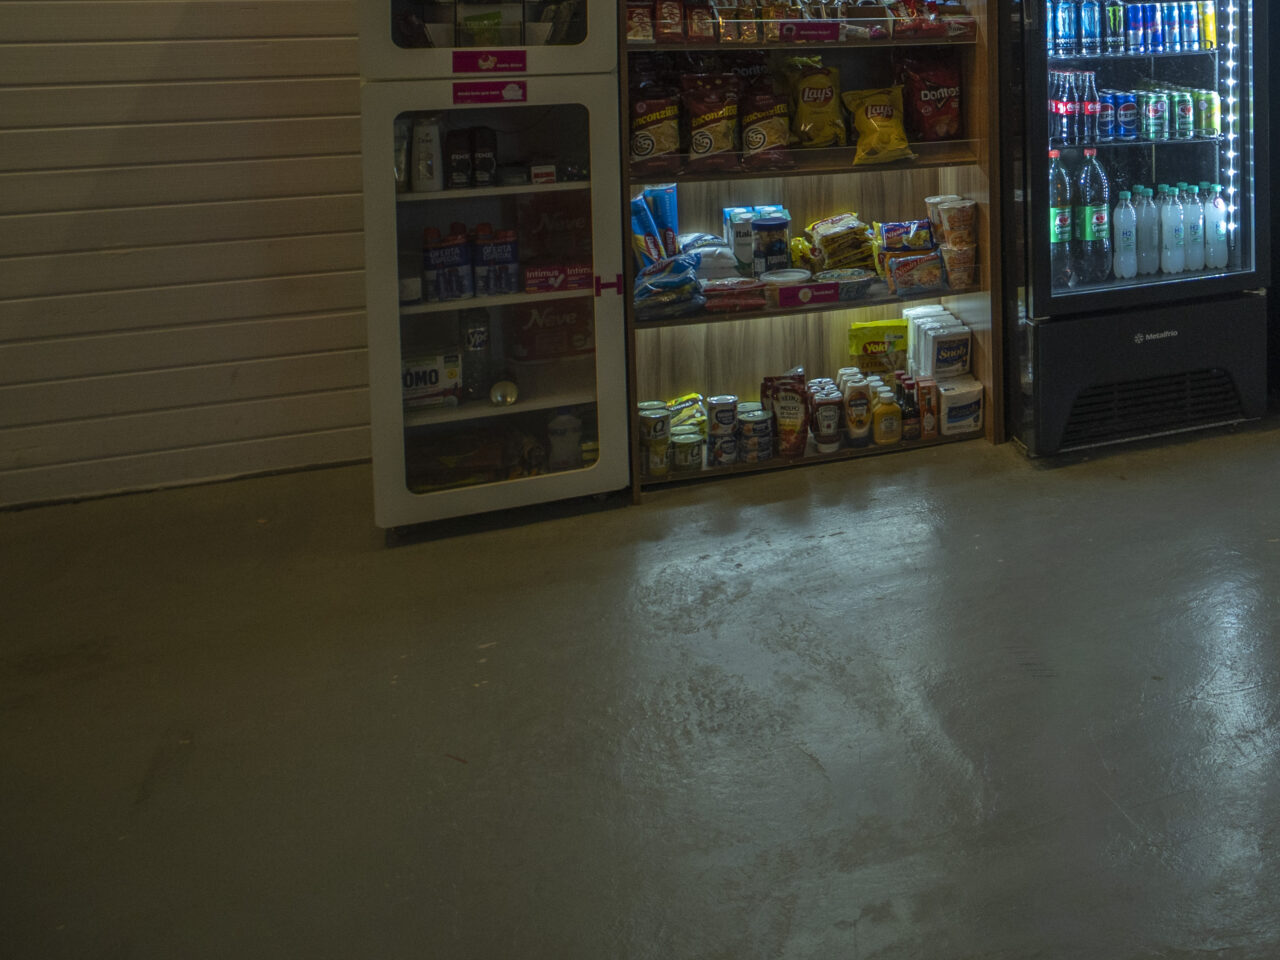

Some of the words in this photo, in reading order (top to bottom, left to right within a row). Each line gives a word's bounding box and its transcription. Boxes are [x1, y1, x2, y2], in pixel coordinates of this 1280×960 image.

[803, 87, 833, 102] Lay's
[867, 104, 894, 119] Lay's
[736, 230, 752, 239] Itala
[526, 270, 559, 279] Intimus
[567, 267, 592, 275] Intim
